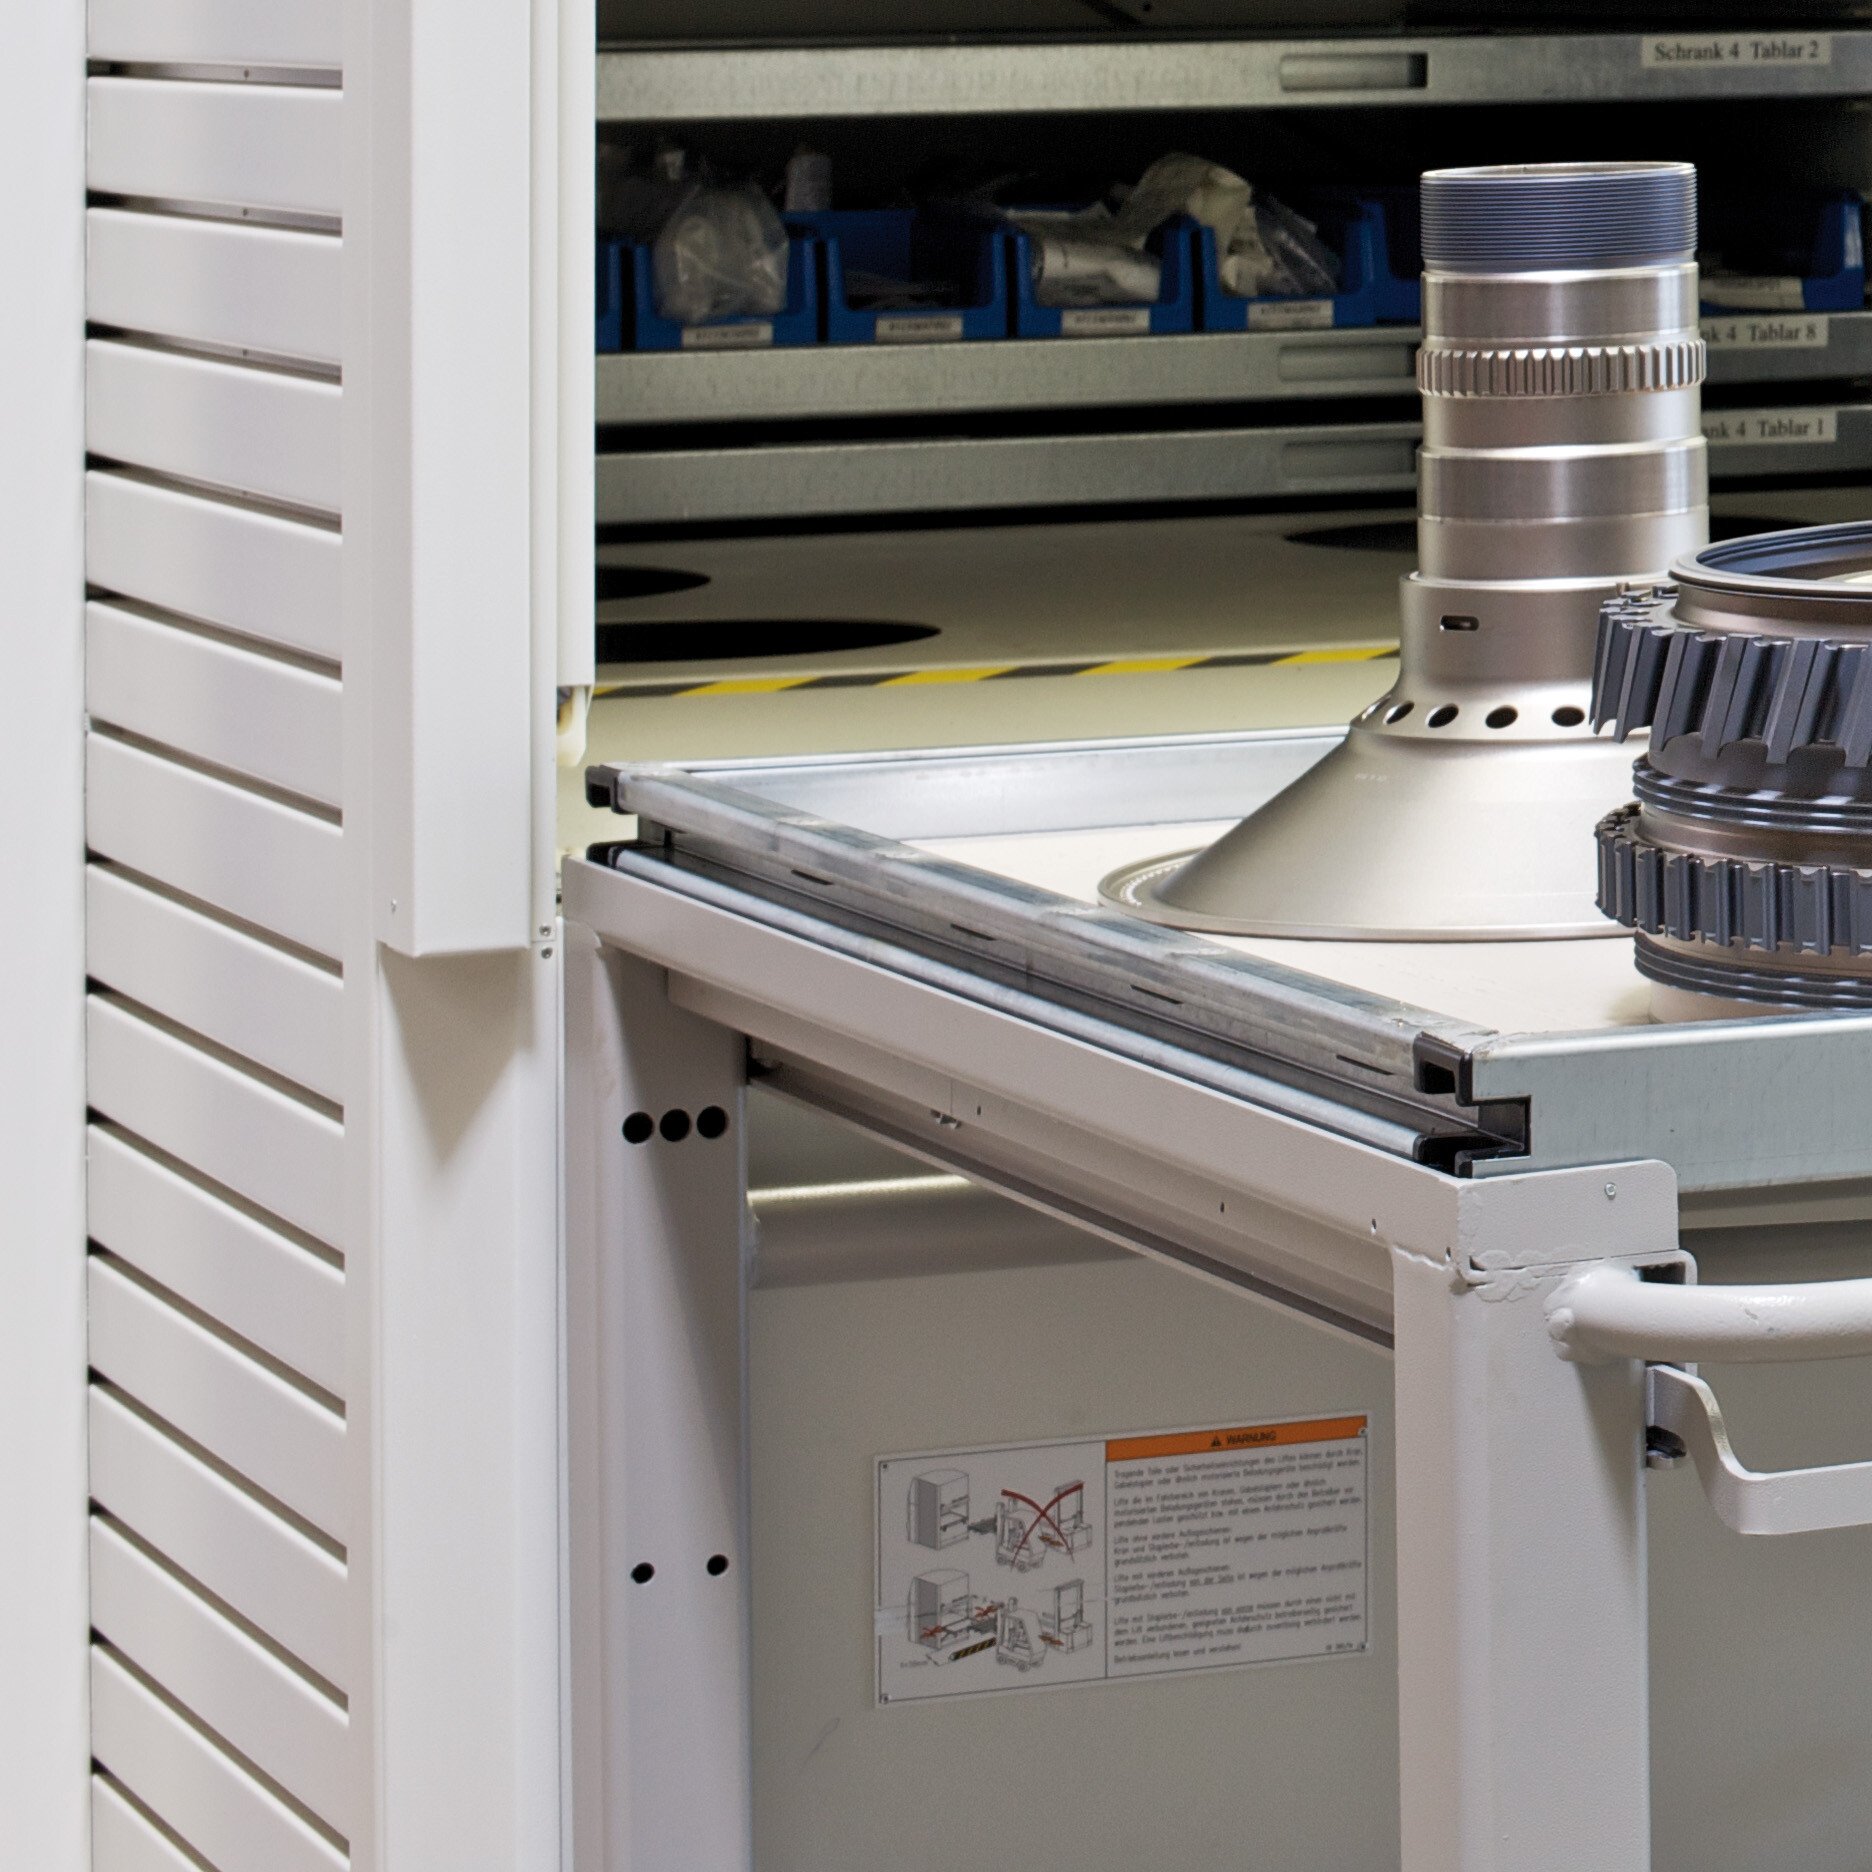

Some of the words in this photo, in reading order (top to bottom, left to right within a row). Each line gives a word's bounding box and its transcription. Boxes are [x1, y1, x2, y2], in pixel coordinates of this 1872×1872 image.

[1654, 40, 1724, 61] Schrank
[1729, 42, 1740, 59] 4
[1750, 40, 1803, 60] Tablar
[1808, 39, 1819, 58] 2
[1725, 327, 1737, 342] 4
[1747, 325, 1800, 342] Tablar
[1806, 323, 1817, 339] 8
[1735, 421, 1746, 436] 4
[1756, 419, 1811, 437] Tablar
